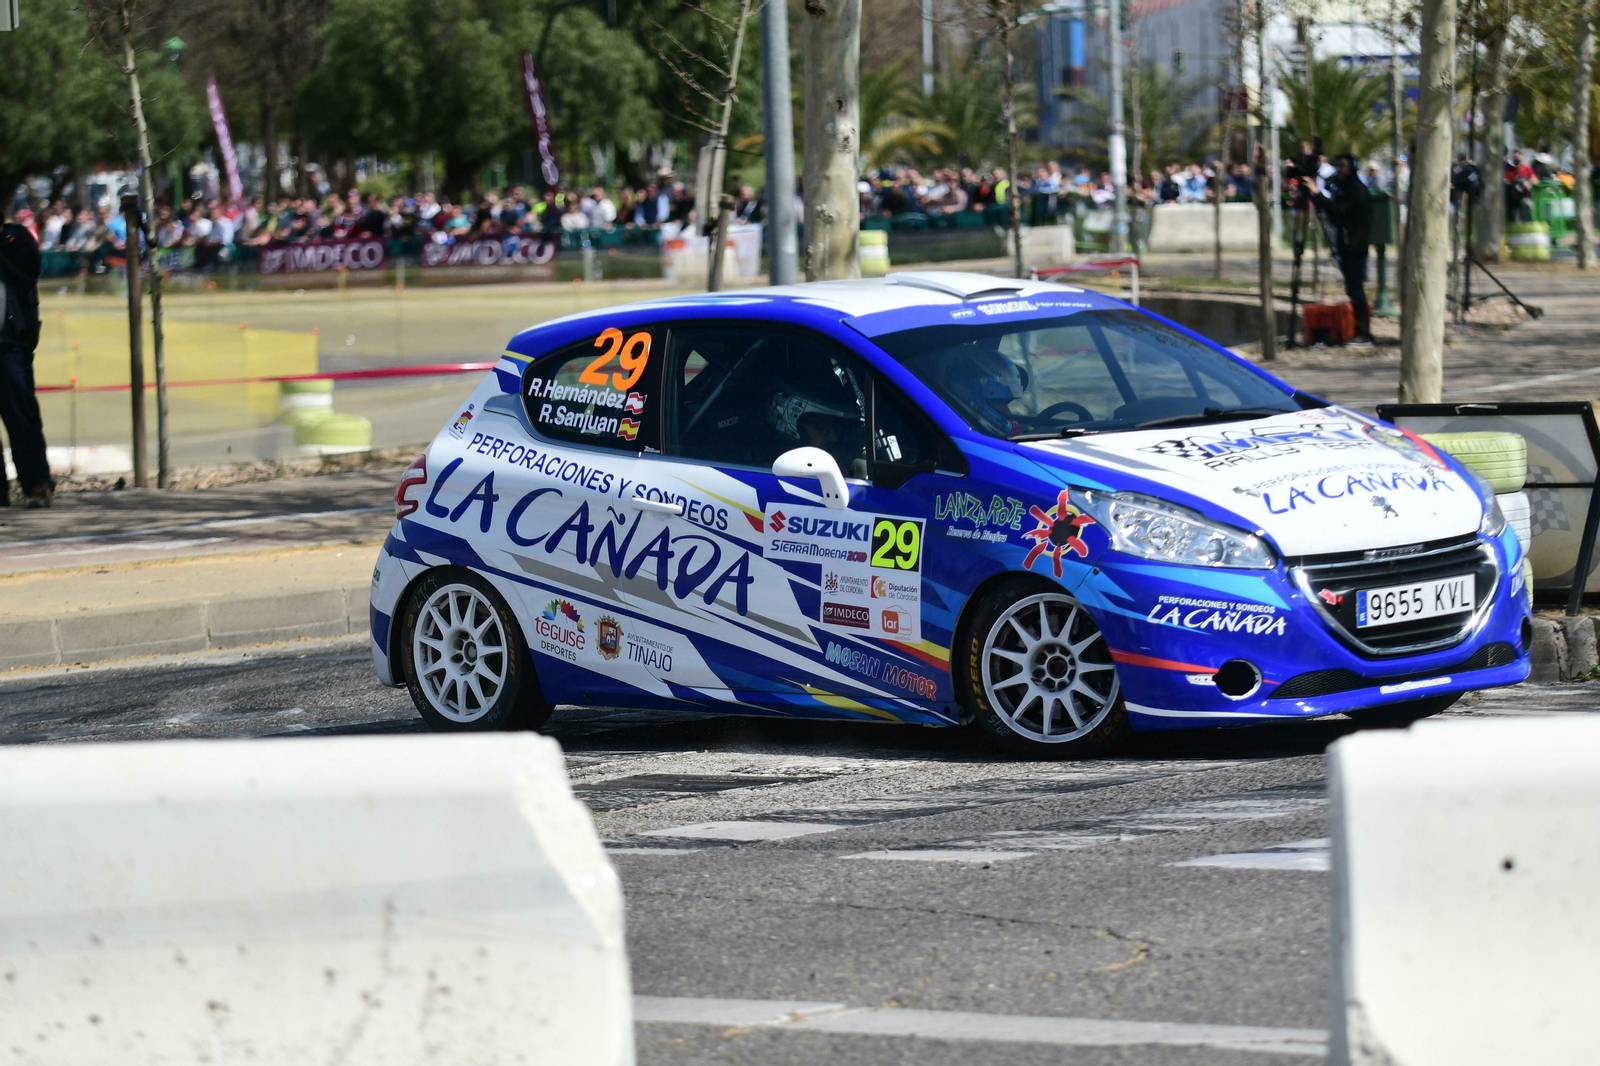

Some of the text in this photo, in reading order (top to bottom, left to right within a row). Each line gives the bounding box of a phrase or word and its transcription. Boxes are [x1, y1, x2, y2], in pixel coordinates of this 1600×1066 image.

[578, 327, 652, 391] 29
[528, 377, 627, 409] R.Hernández
[538, 403, 618, 434] R.Sanjuan
[467, 432, 614, 494] PERFORACIONES
[617, 477, 632, 500] Y
[1262, 486, 1316, 514] LA
[1317, 471, 1456, 499] CAÑADA
[935, 492, 1026, 530] LANZAROTE
[425, 457, 755, 617] LA CAÑADA
[787, 516, 870, 542] SUZUKI
[870, 520, 920, 570] 29
[840, 575, 869, 587] AYUNTAMIENTO
[840, 584, 846, 592] DE
[888, 582, 918, 594] Diputación
[834, 607, 869, 621] IMDECO
[1158, 595, 1275, 614] PERFORACIONES Y SONDEOS
[1370, 579, 1470, 621] 9655 KVL
[883, 615, 898, 630] lar
[1146, 604, 1287, 636] LA CAÑADA
[1359, 613, 1366, 622] E
[540, 640, 577, 661] DEPORTES
[627, 632, 673, 654] AYUNTAMIENTO DE
[627, 641, 672, 672] TINAJO
[825, 641, 937, 702] MOSAN MOTOR
[969, 637, 983, 697] ZERO
